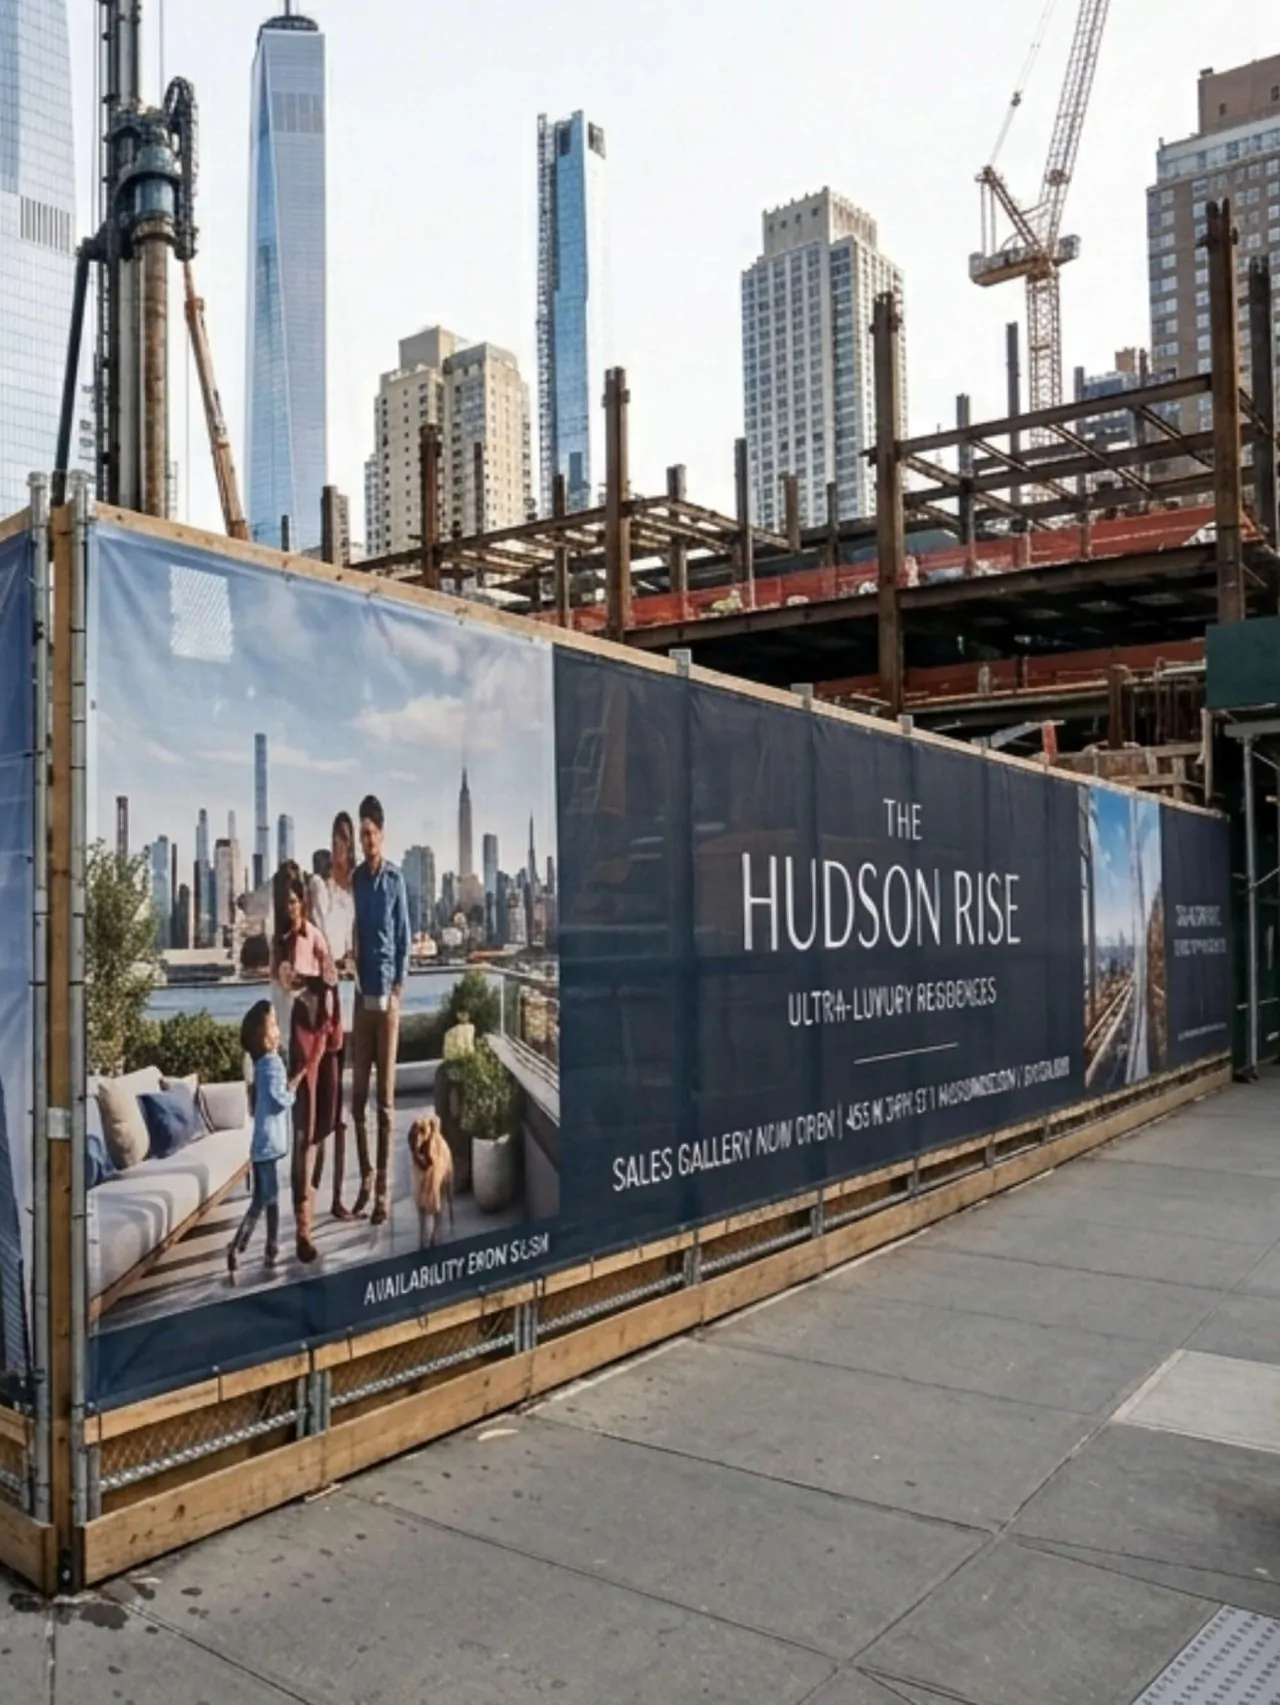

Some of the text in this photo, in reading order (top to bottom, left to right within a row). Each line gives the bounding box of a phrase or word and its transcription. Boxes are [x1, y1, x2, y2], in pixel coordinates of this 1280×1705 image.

[883, 798, 922, 840] THE
[742, 852, 1021, 951] HUDSON RISE
[613, 1147, 672, 1192] SALES
[678, 1129, 753, 1176] GALLERY
[364, 1257, 465, 1305] AVAILABILITY
